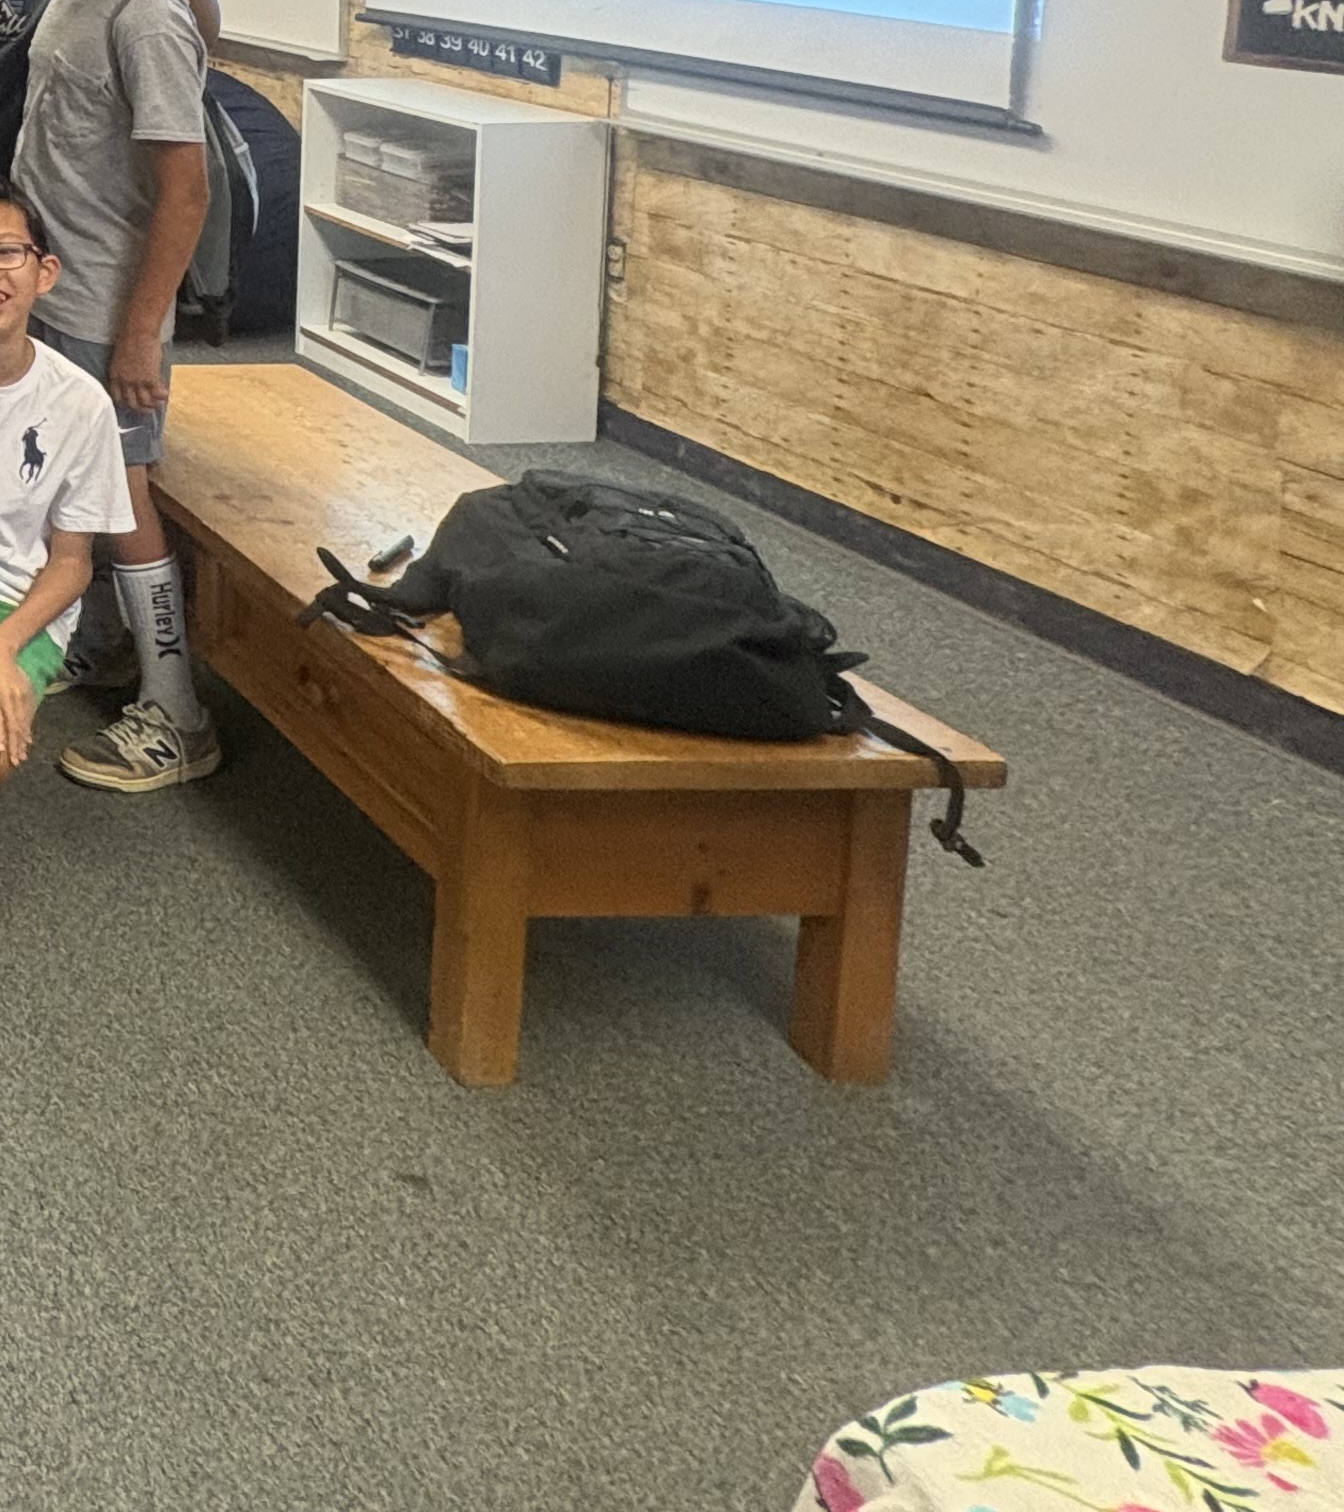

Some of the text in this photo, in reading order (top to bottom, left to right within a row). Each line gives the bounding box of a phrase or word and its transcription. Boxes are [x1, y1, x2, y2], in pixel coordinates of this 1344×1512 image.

[440, 36, 462, 51] 39
[467, 38, 490, 57] 40
[494, 44, 516, 63] 41
[522, 49, 549, 71] 42
[150, 581, 175, 636] Hurley
[143, 738, 179, 769] N
